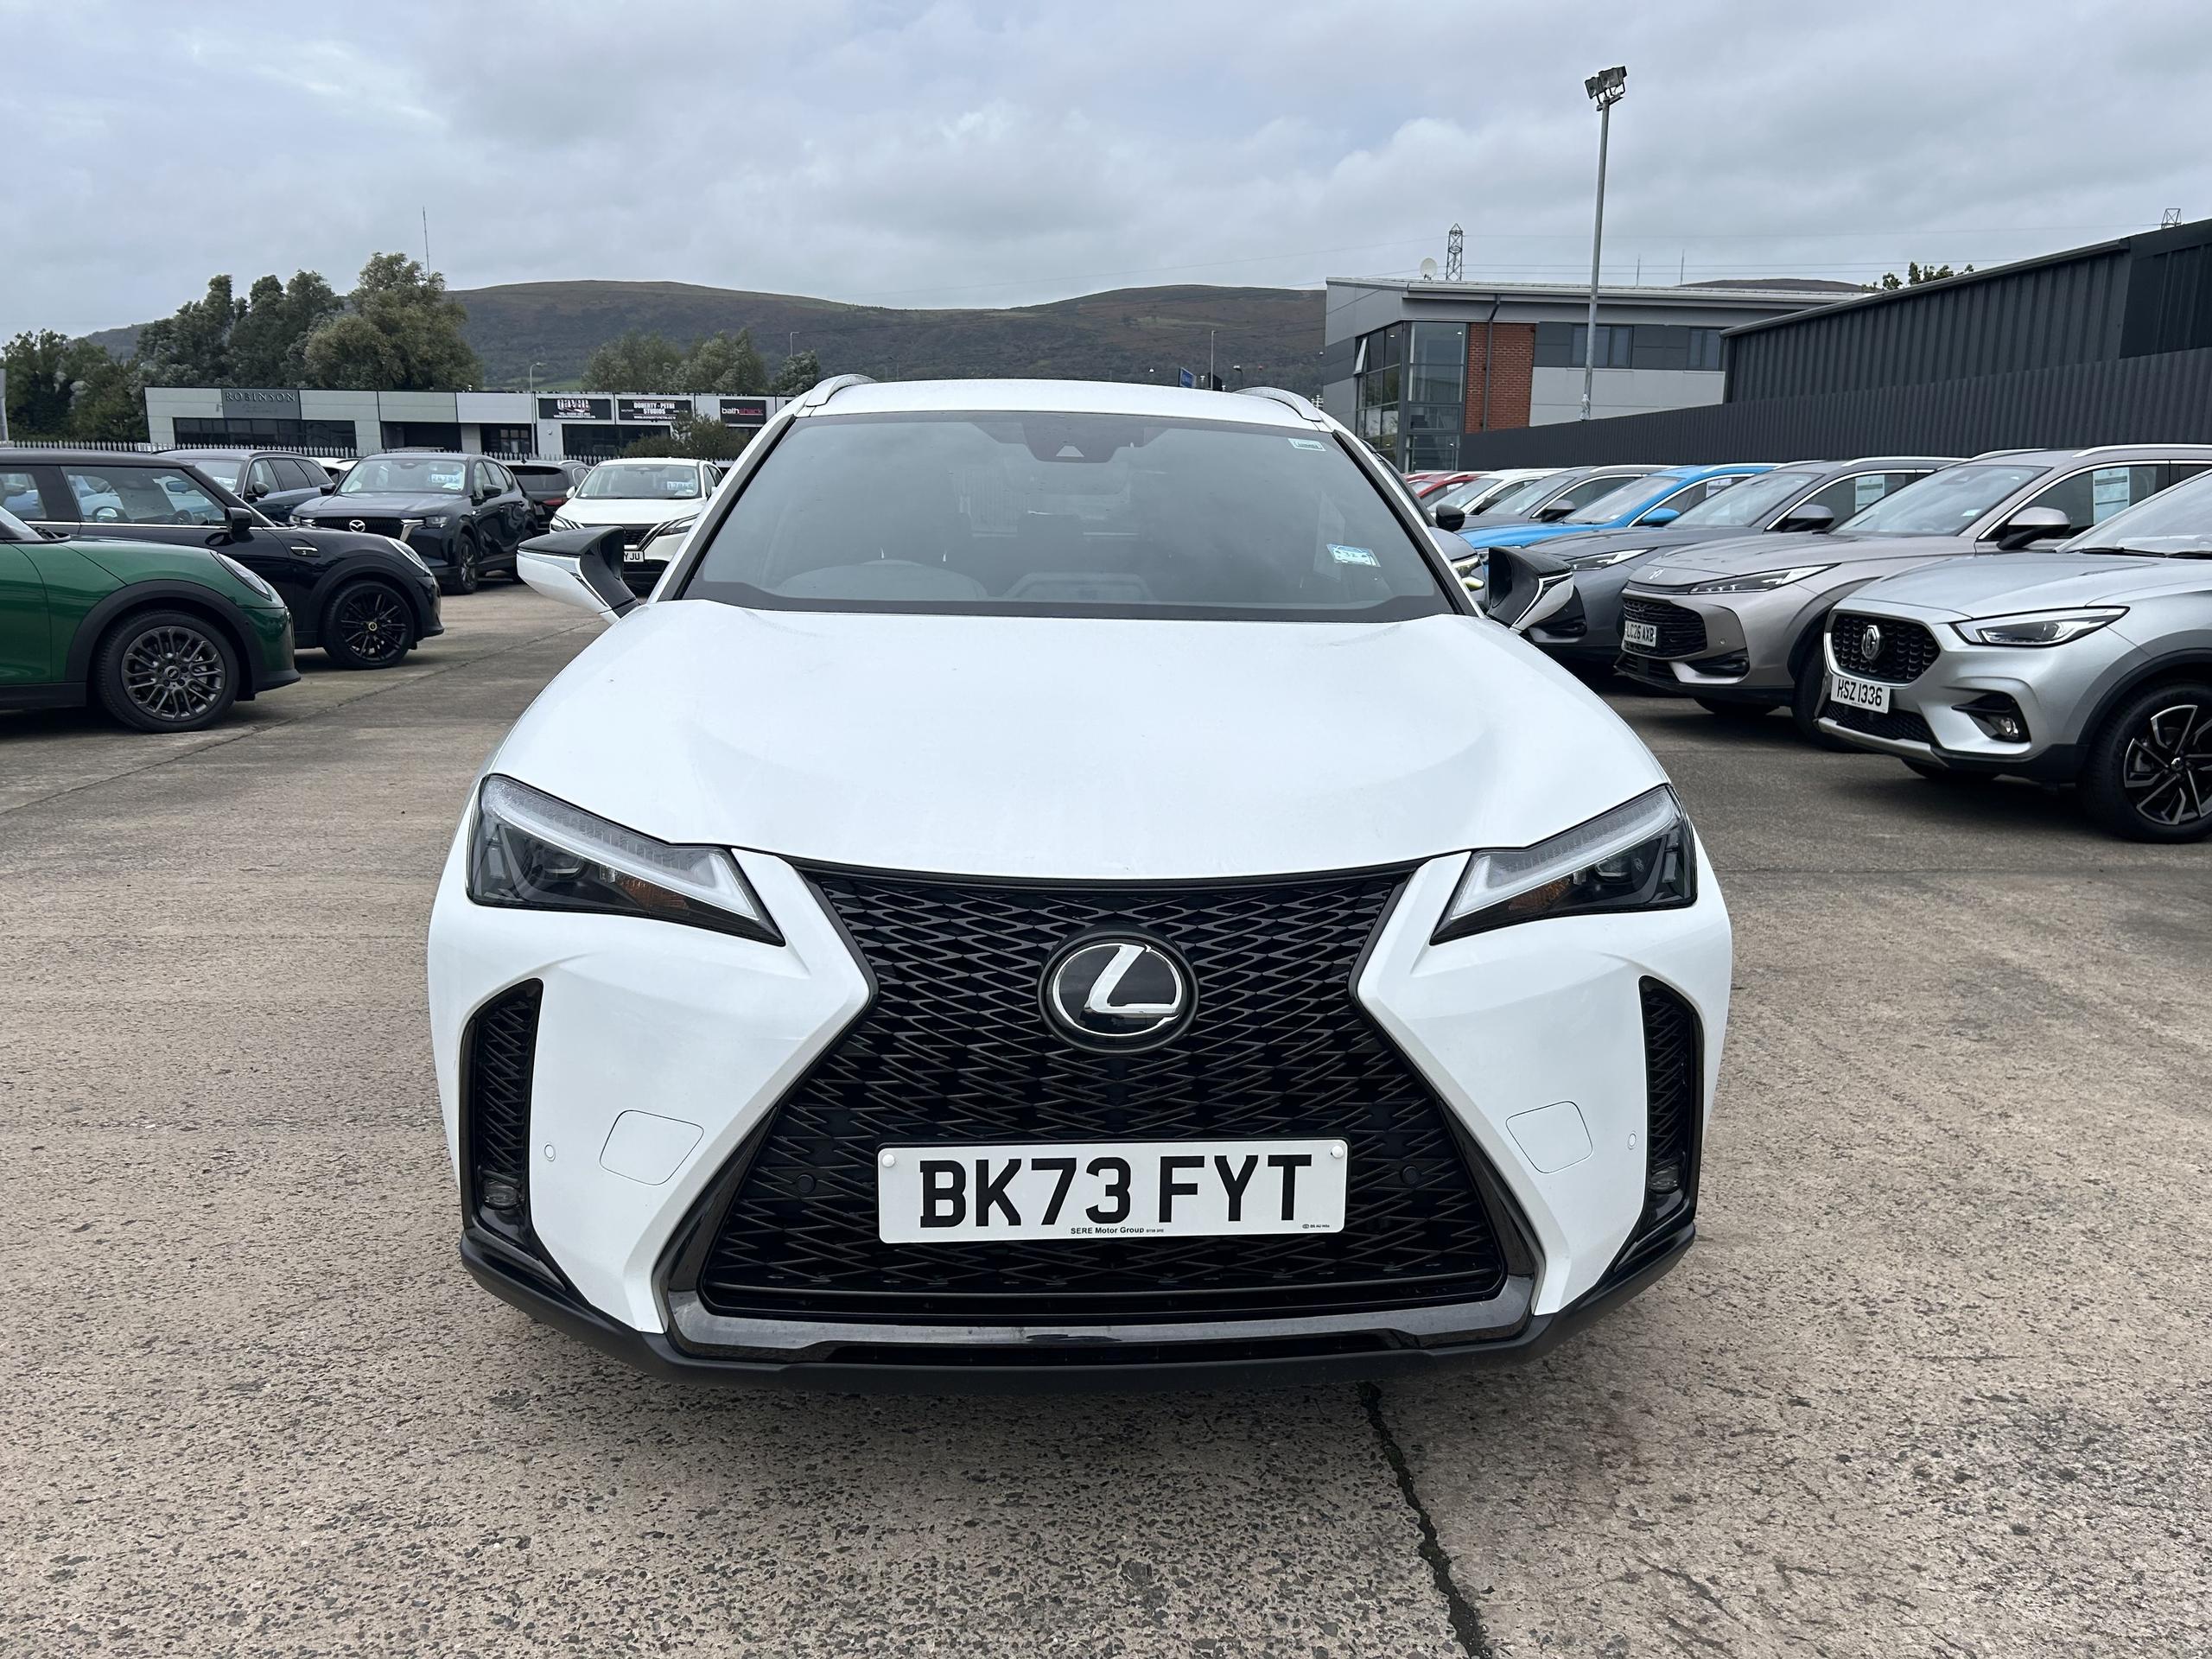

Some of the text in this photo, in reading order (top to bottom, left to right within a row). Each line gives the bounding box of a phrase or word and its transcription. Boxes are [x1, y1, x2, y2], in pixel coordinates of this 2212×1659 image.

[226, 391, 296, 403] ROBINSON
[1837, 678, 1857, 701] HSZ
[918, 1154, 1313, 1229] BK73 FYT
